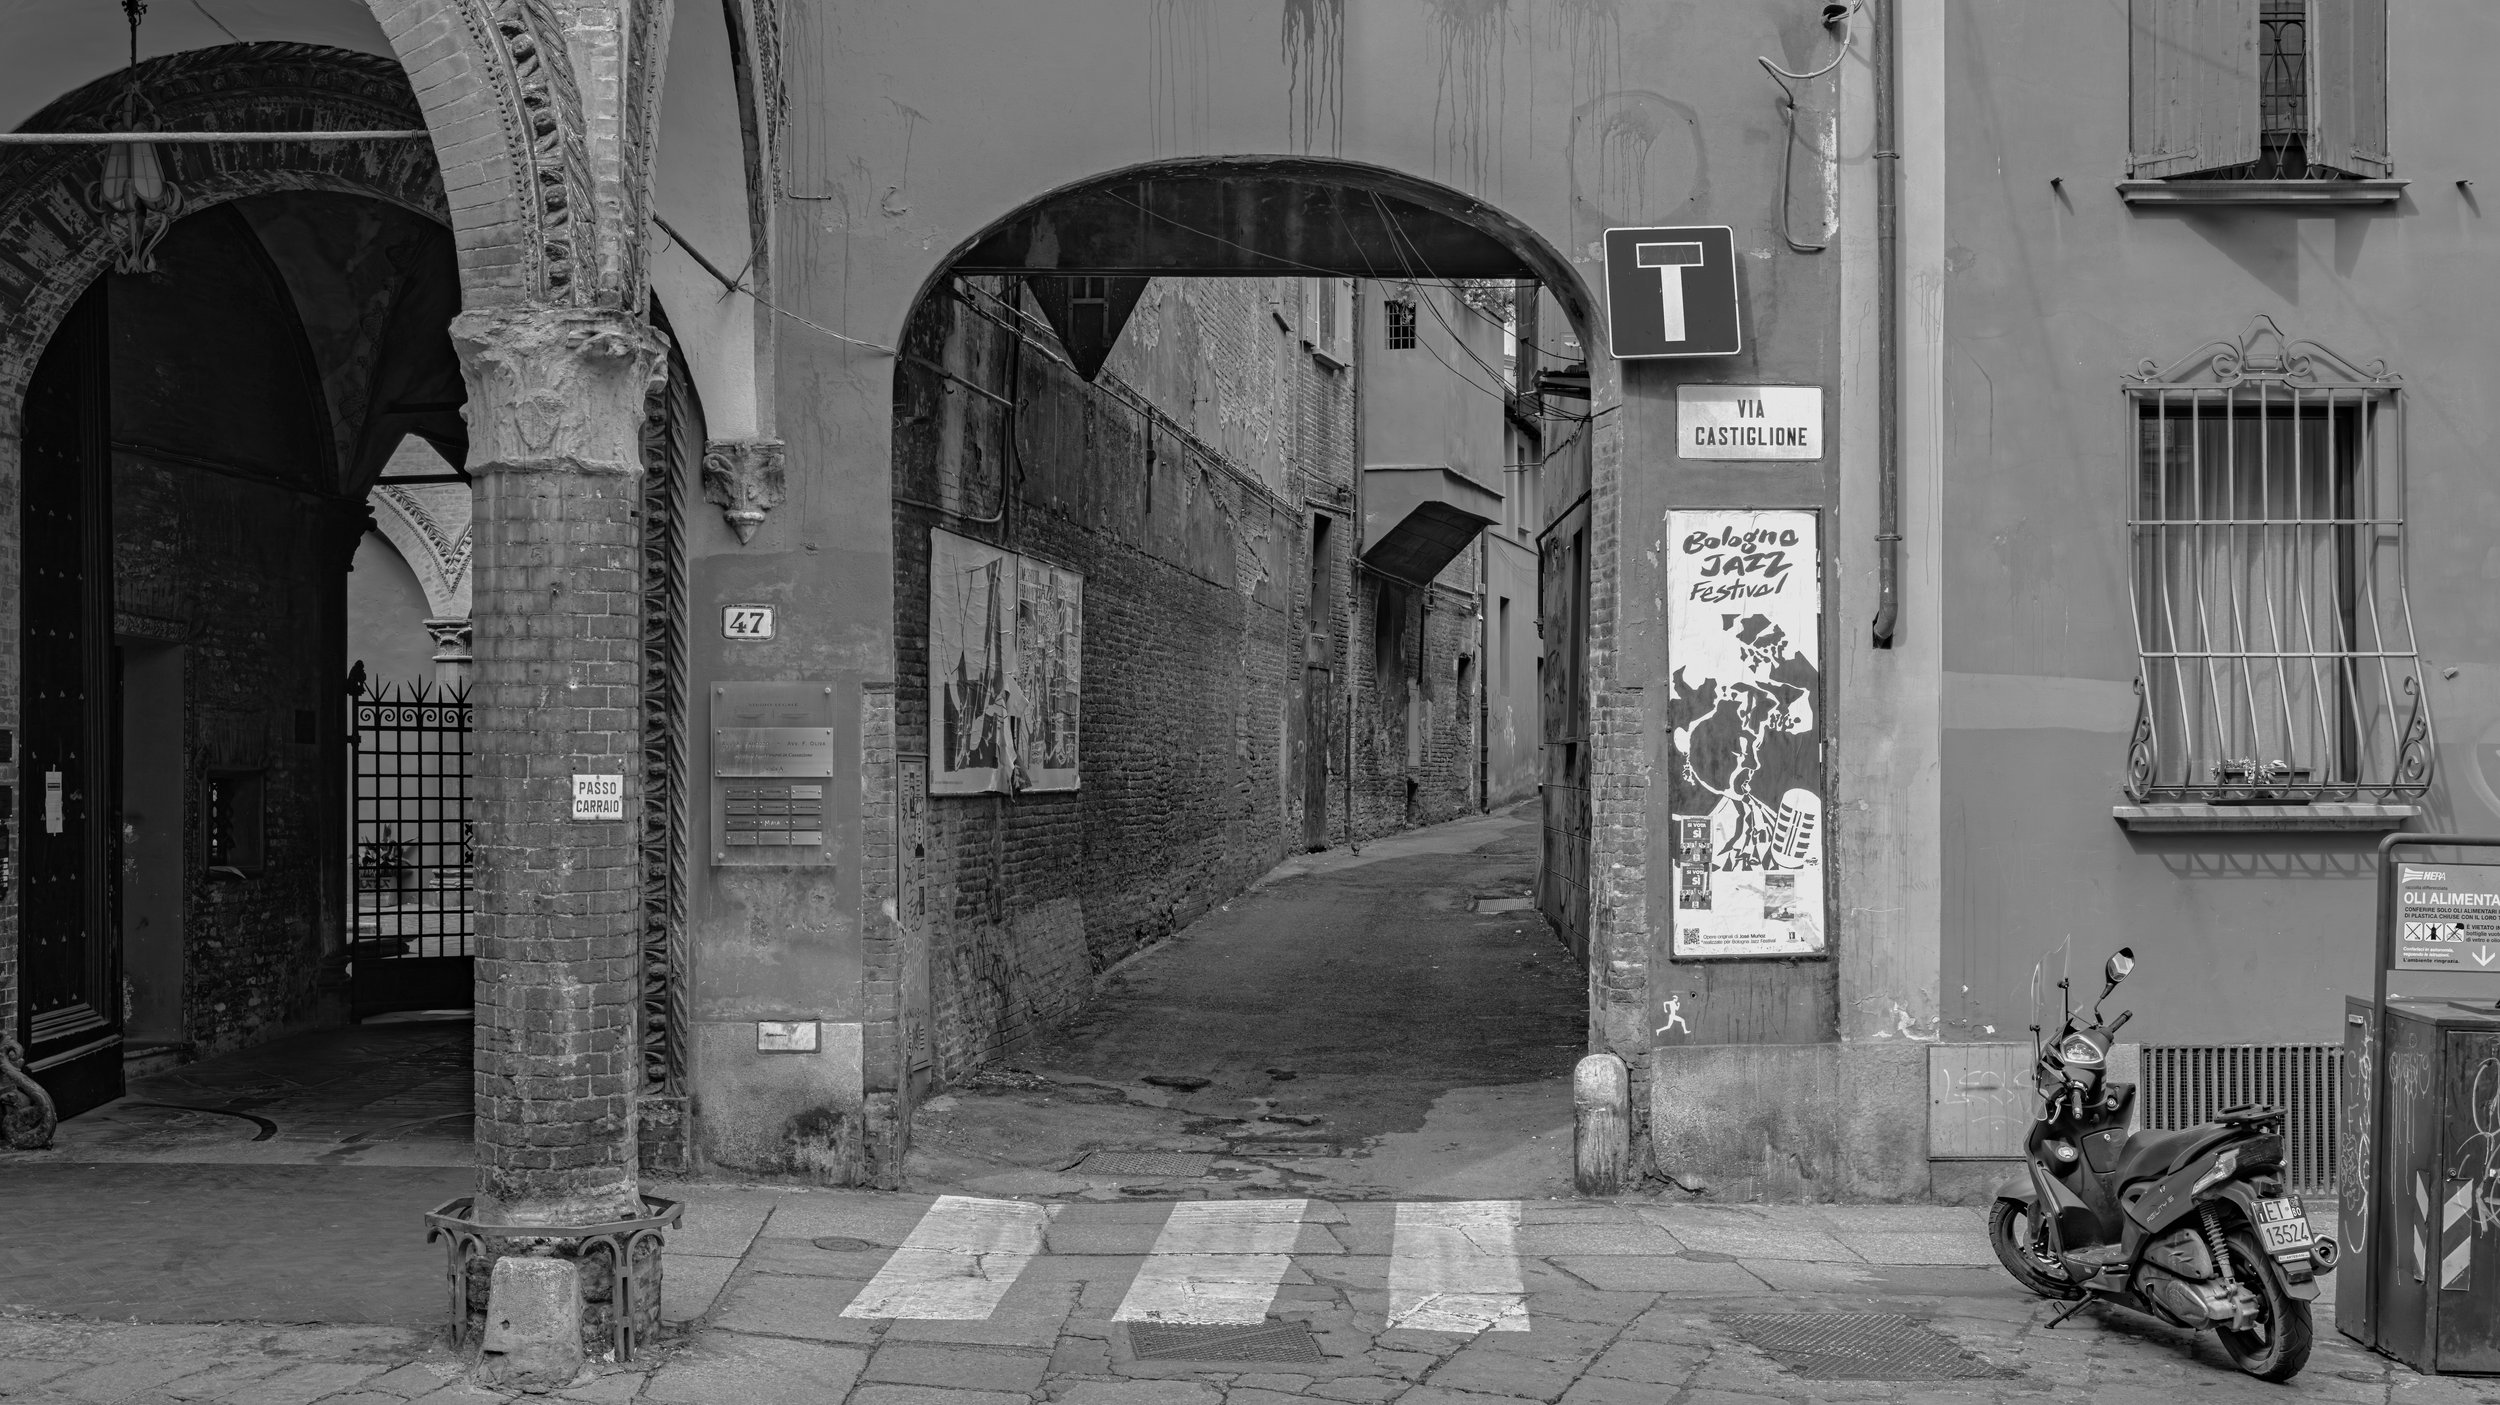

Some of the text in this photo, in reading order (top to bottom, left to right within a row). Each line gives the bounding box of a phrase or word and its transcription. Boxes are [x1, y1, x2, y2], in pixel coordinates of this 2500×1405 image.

[1737, 399, 1765, 419] VIA
[1695, 426, 1808, 446] CASTIGLIONE
[1682, 526, 1799, 556] Bologna
[1700, 552, 1793, 578] JAZZ
[1689, 573, 1789, 604] Festival
[729, 611, 765, 635] 47
[578, 781, 617, 795] PASSO
[576, 799, 619, 813] CARRAIO
[2423, 871, 2446, 881] HERA
[2403, 891, 2426, 905] OLI
[2265, 1201, 2284, 1221] ET
[2266, 1222, 2309, 1247] 13524
